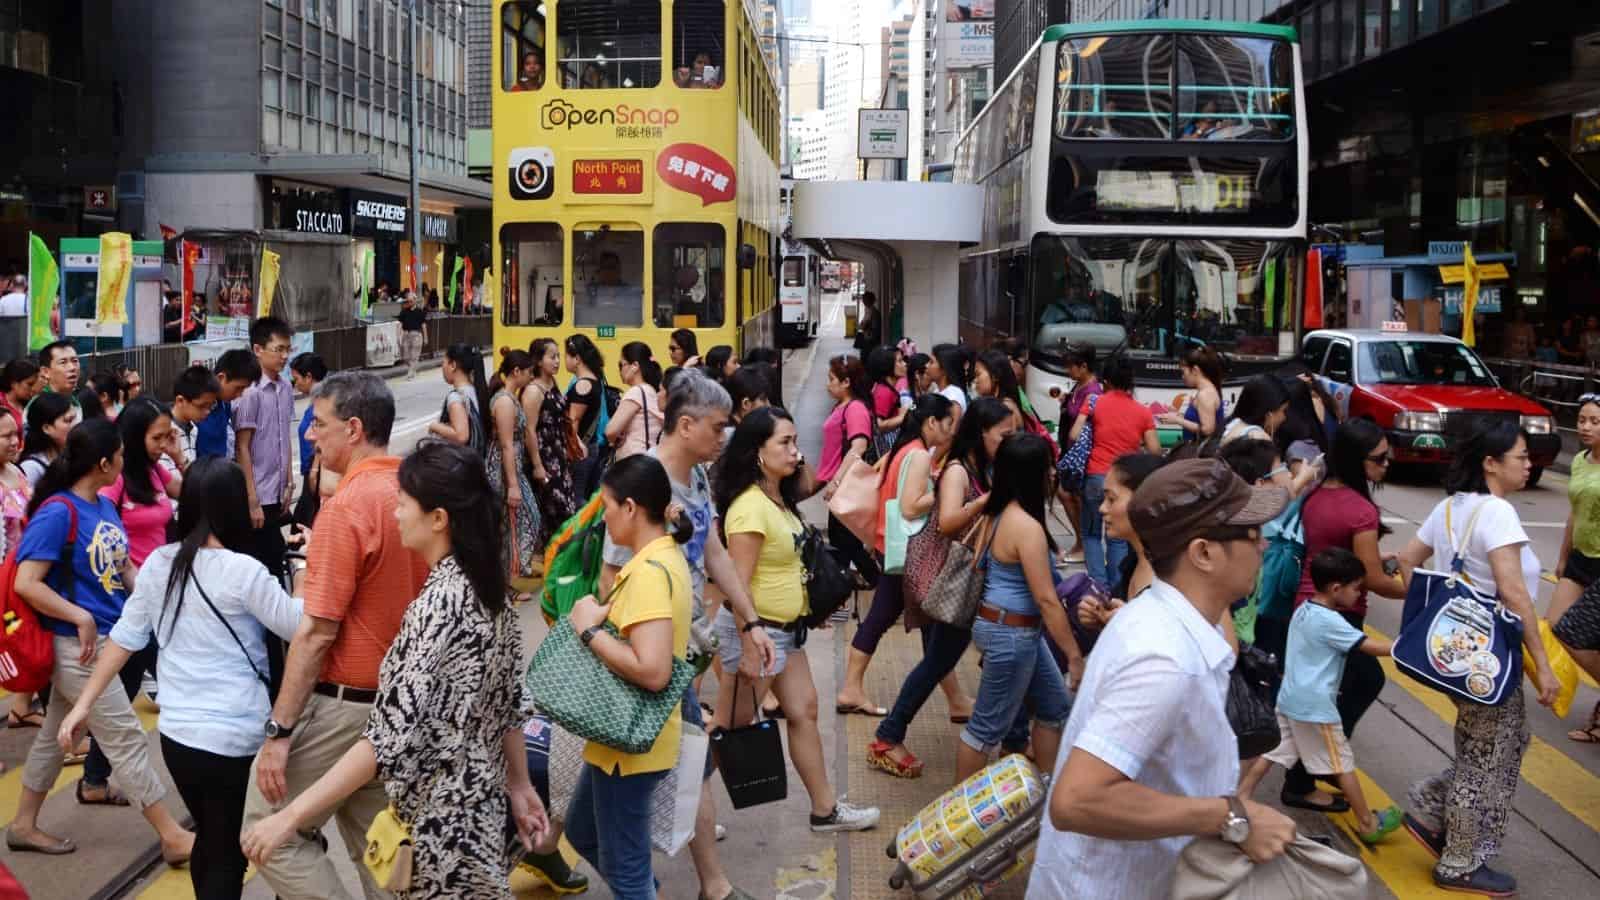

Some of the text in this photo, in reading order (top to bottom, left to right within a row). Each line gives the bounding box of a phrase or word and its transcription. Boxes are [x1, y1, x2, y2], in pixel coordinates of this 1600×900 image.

[548, 104, 679, 130] OpenSnap
[575, 161, 641, 174] North Point
[667, 155, 729, 192] 免費下載
[296, 209, 343, 233] STACCATO
[356, 200, 406, 220] SKECHERS
